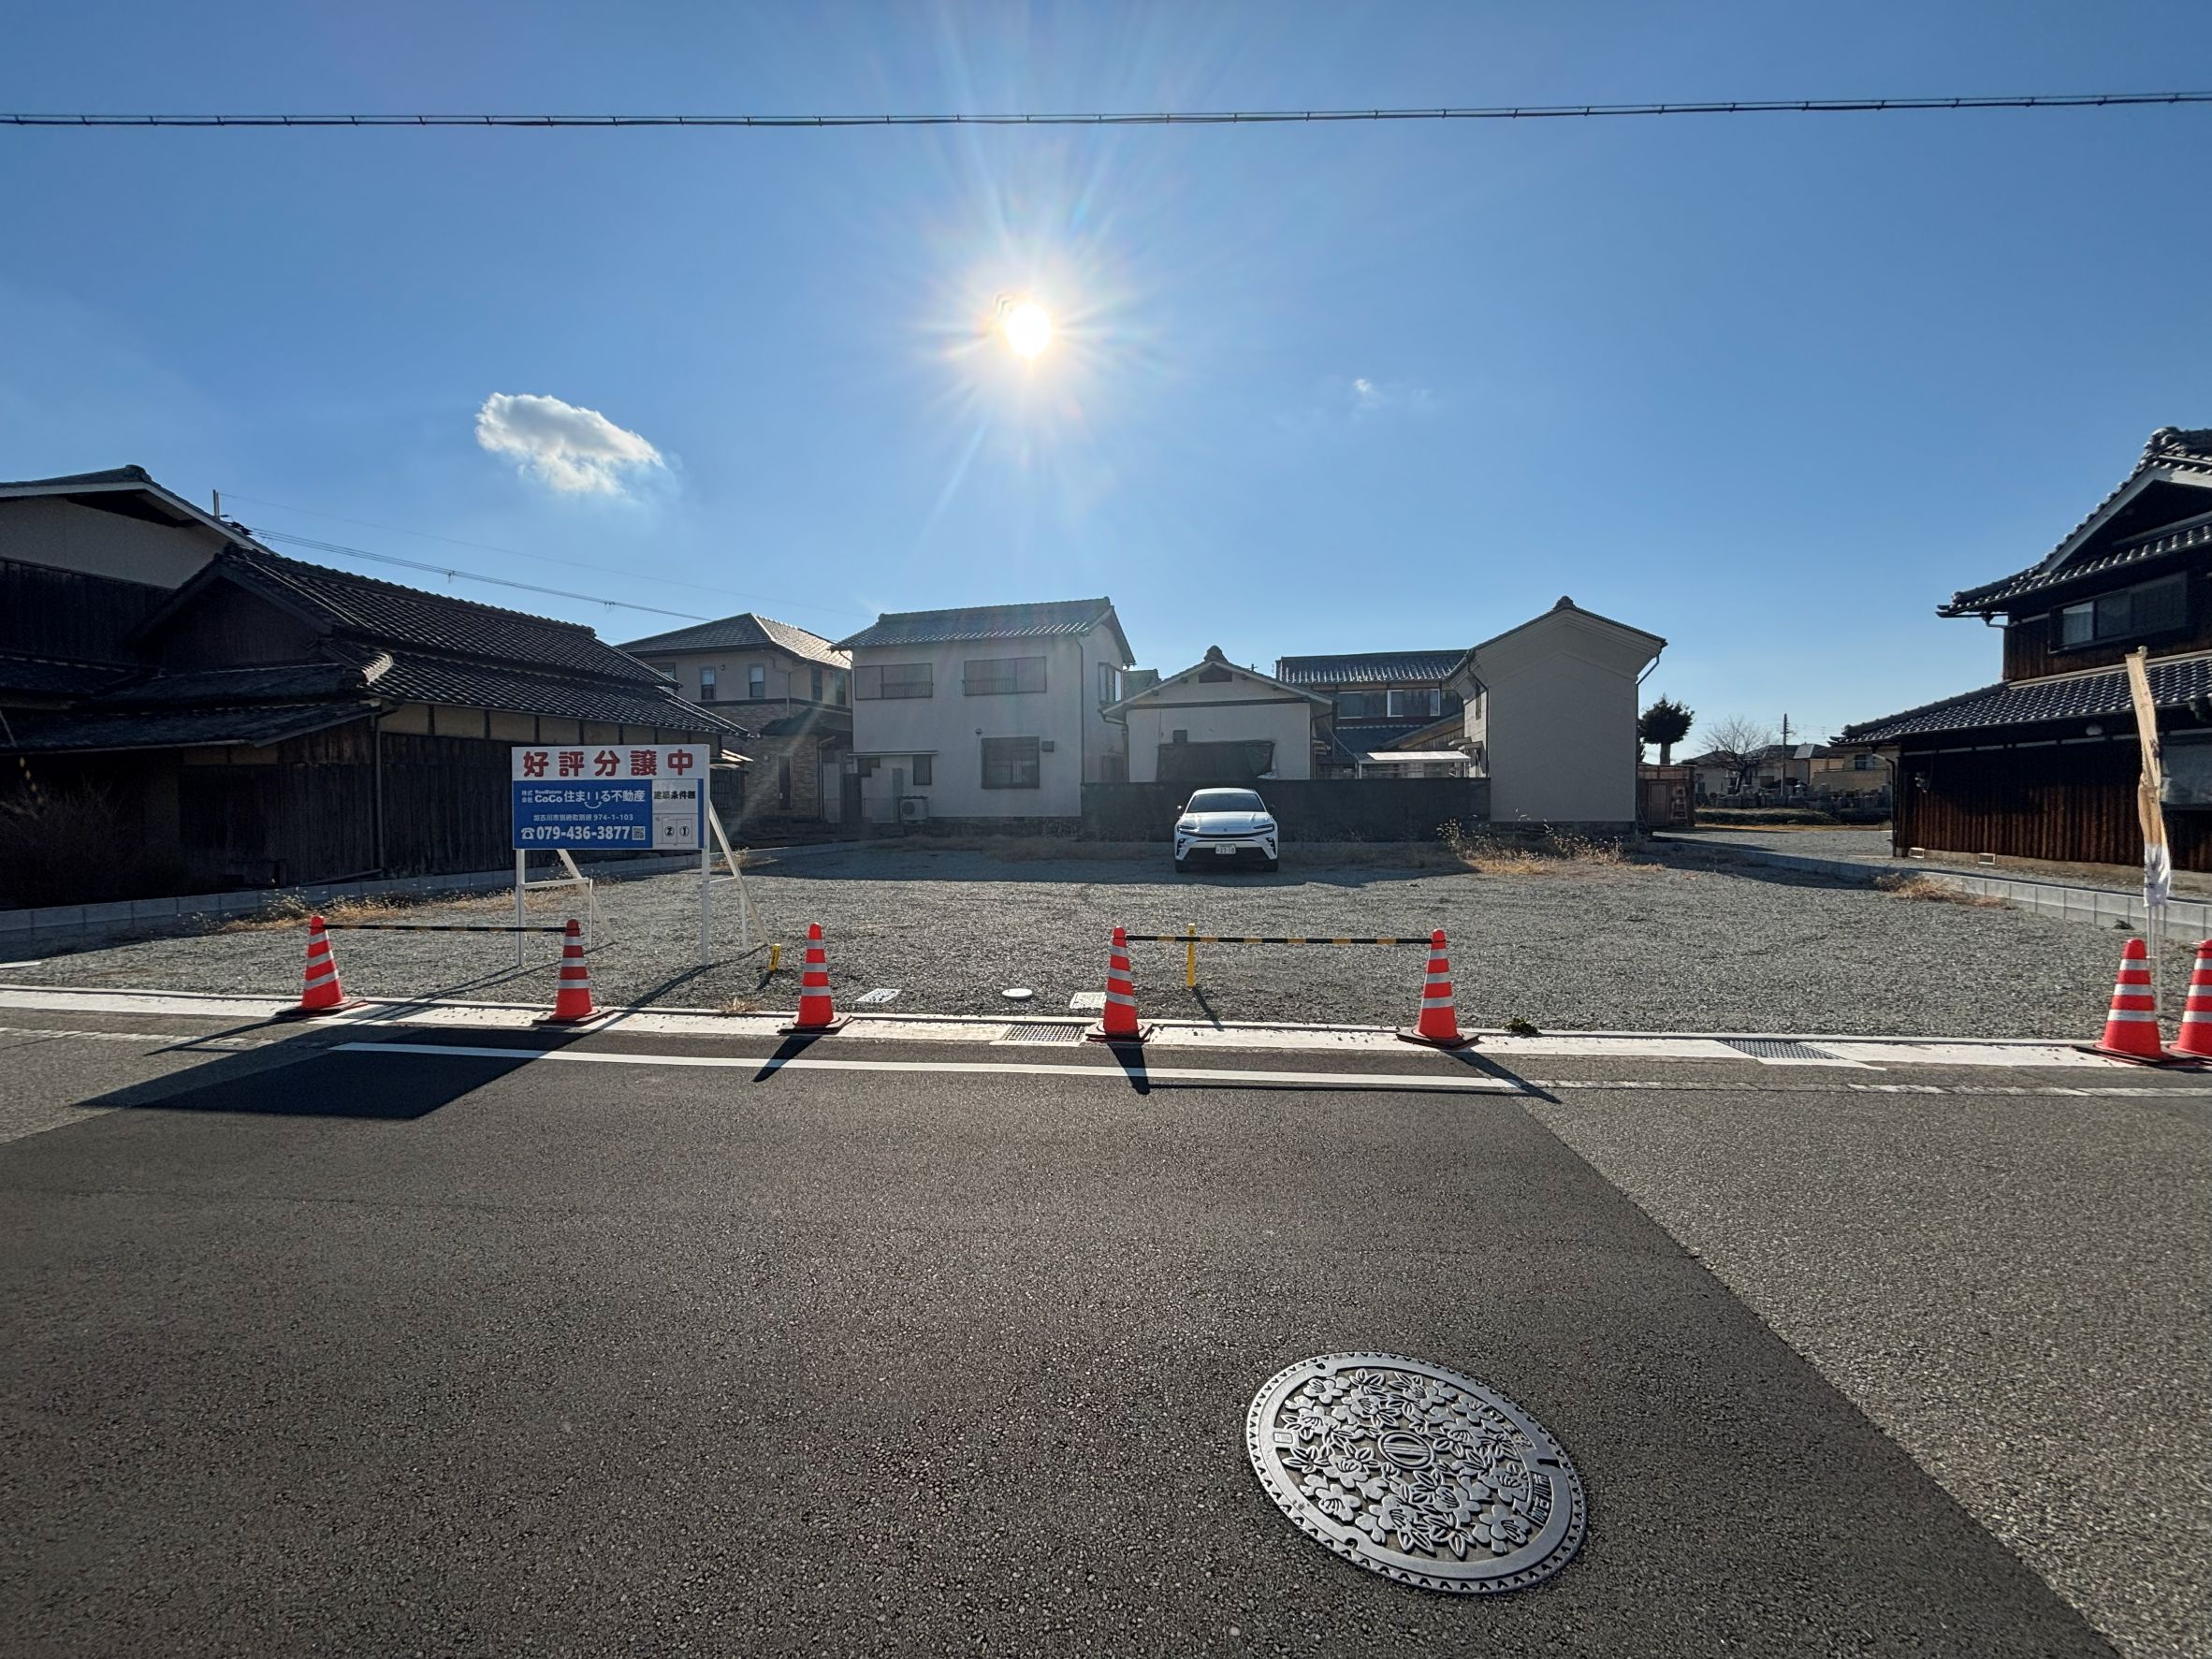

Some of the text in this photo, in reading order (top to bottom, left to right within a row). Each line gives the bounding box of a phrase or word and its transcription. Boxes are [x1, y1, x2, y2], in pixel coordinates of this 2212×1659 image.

[523, 749, 693, 778] 好評分譲中
[534, 794, 563, 803] CoCo
[536, 825, 631, 840] 079-436-3877
